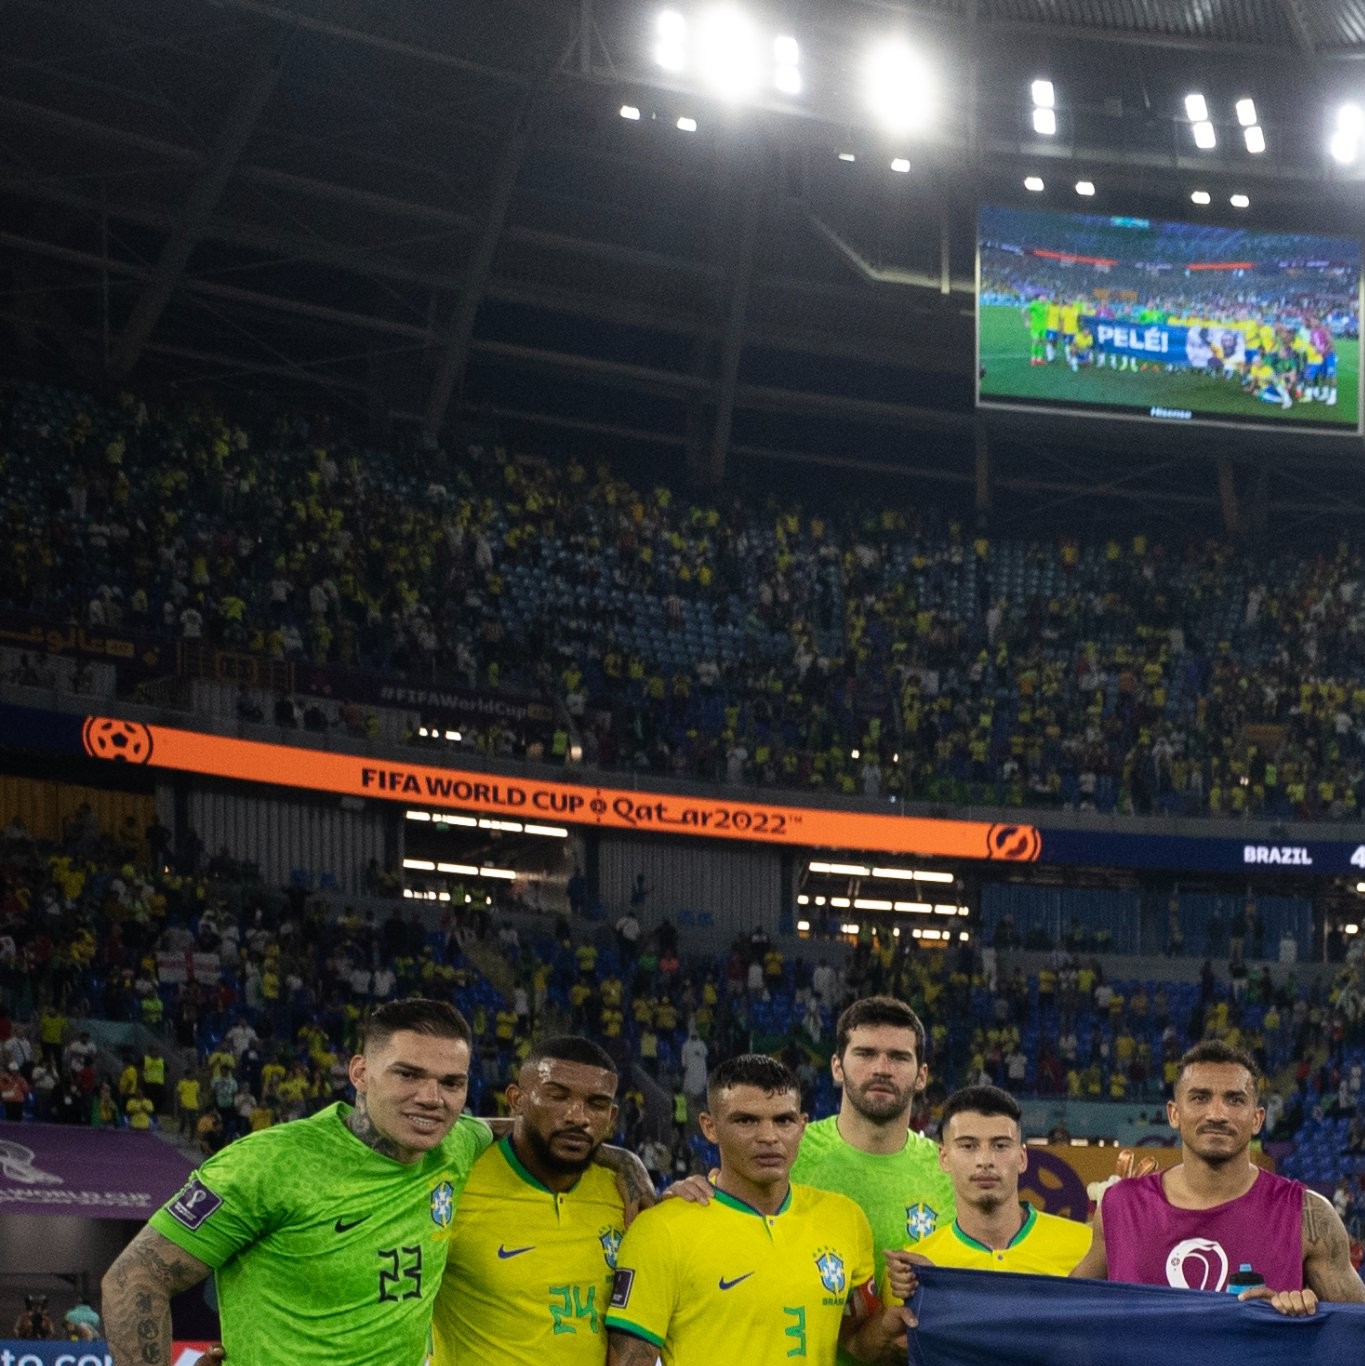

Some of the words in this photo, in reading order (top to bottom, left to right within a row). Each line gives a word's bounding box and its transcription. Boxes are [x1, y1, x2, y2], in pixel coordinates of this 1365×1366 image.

[1098, 325, 1168, 353] PELÉ!
[361, 768, 421, 794] FIFA
[426, 776, 526, 807] WORLD
[533, 791, 585, 814] CUP
[1244, 845, 1312, 865] BRAZIL
[378, 1245, 422, 1302] 23
[549, 1285, 598, 1335] 24
[784, 1305, 807, 1358] 3
